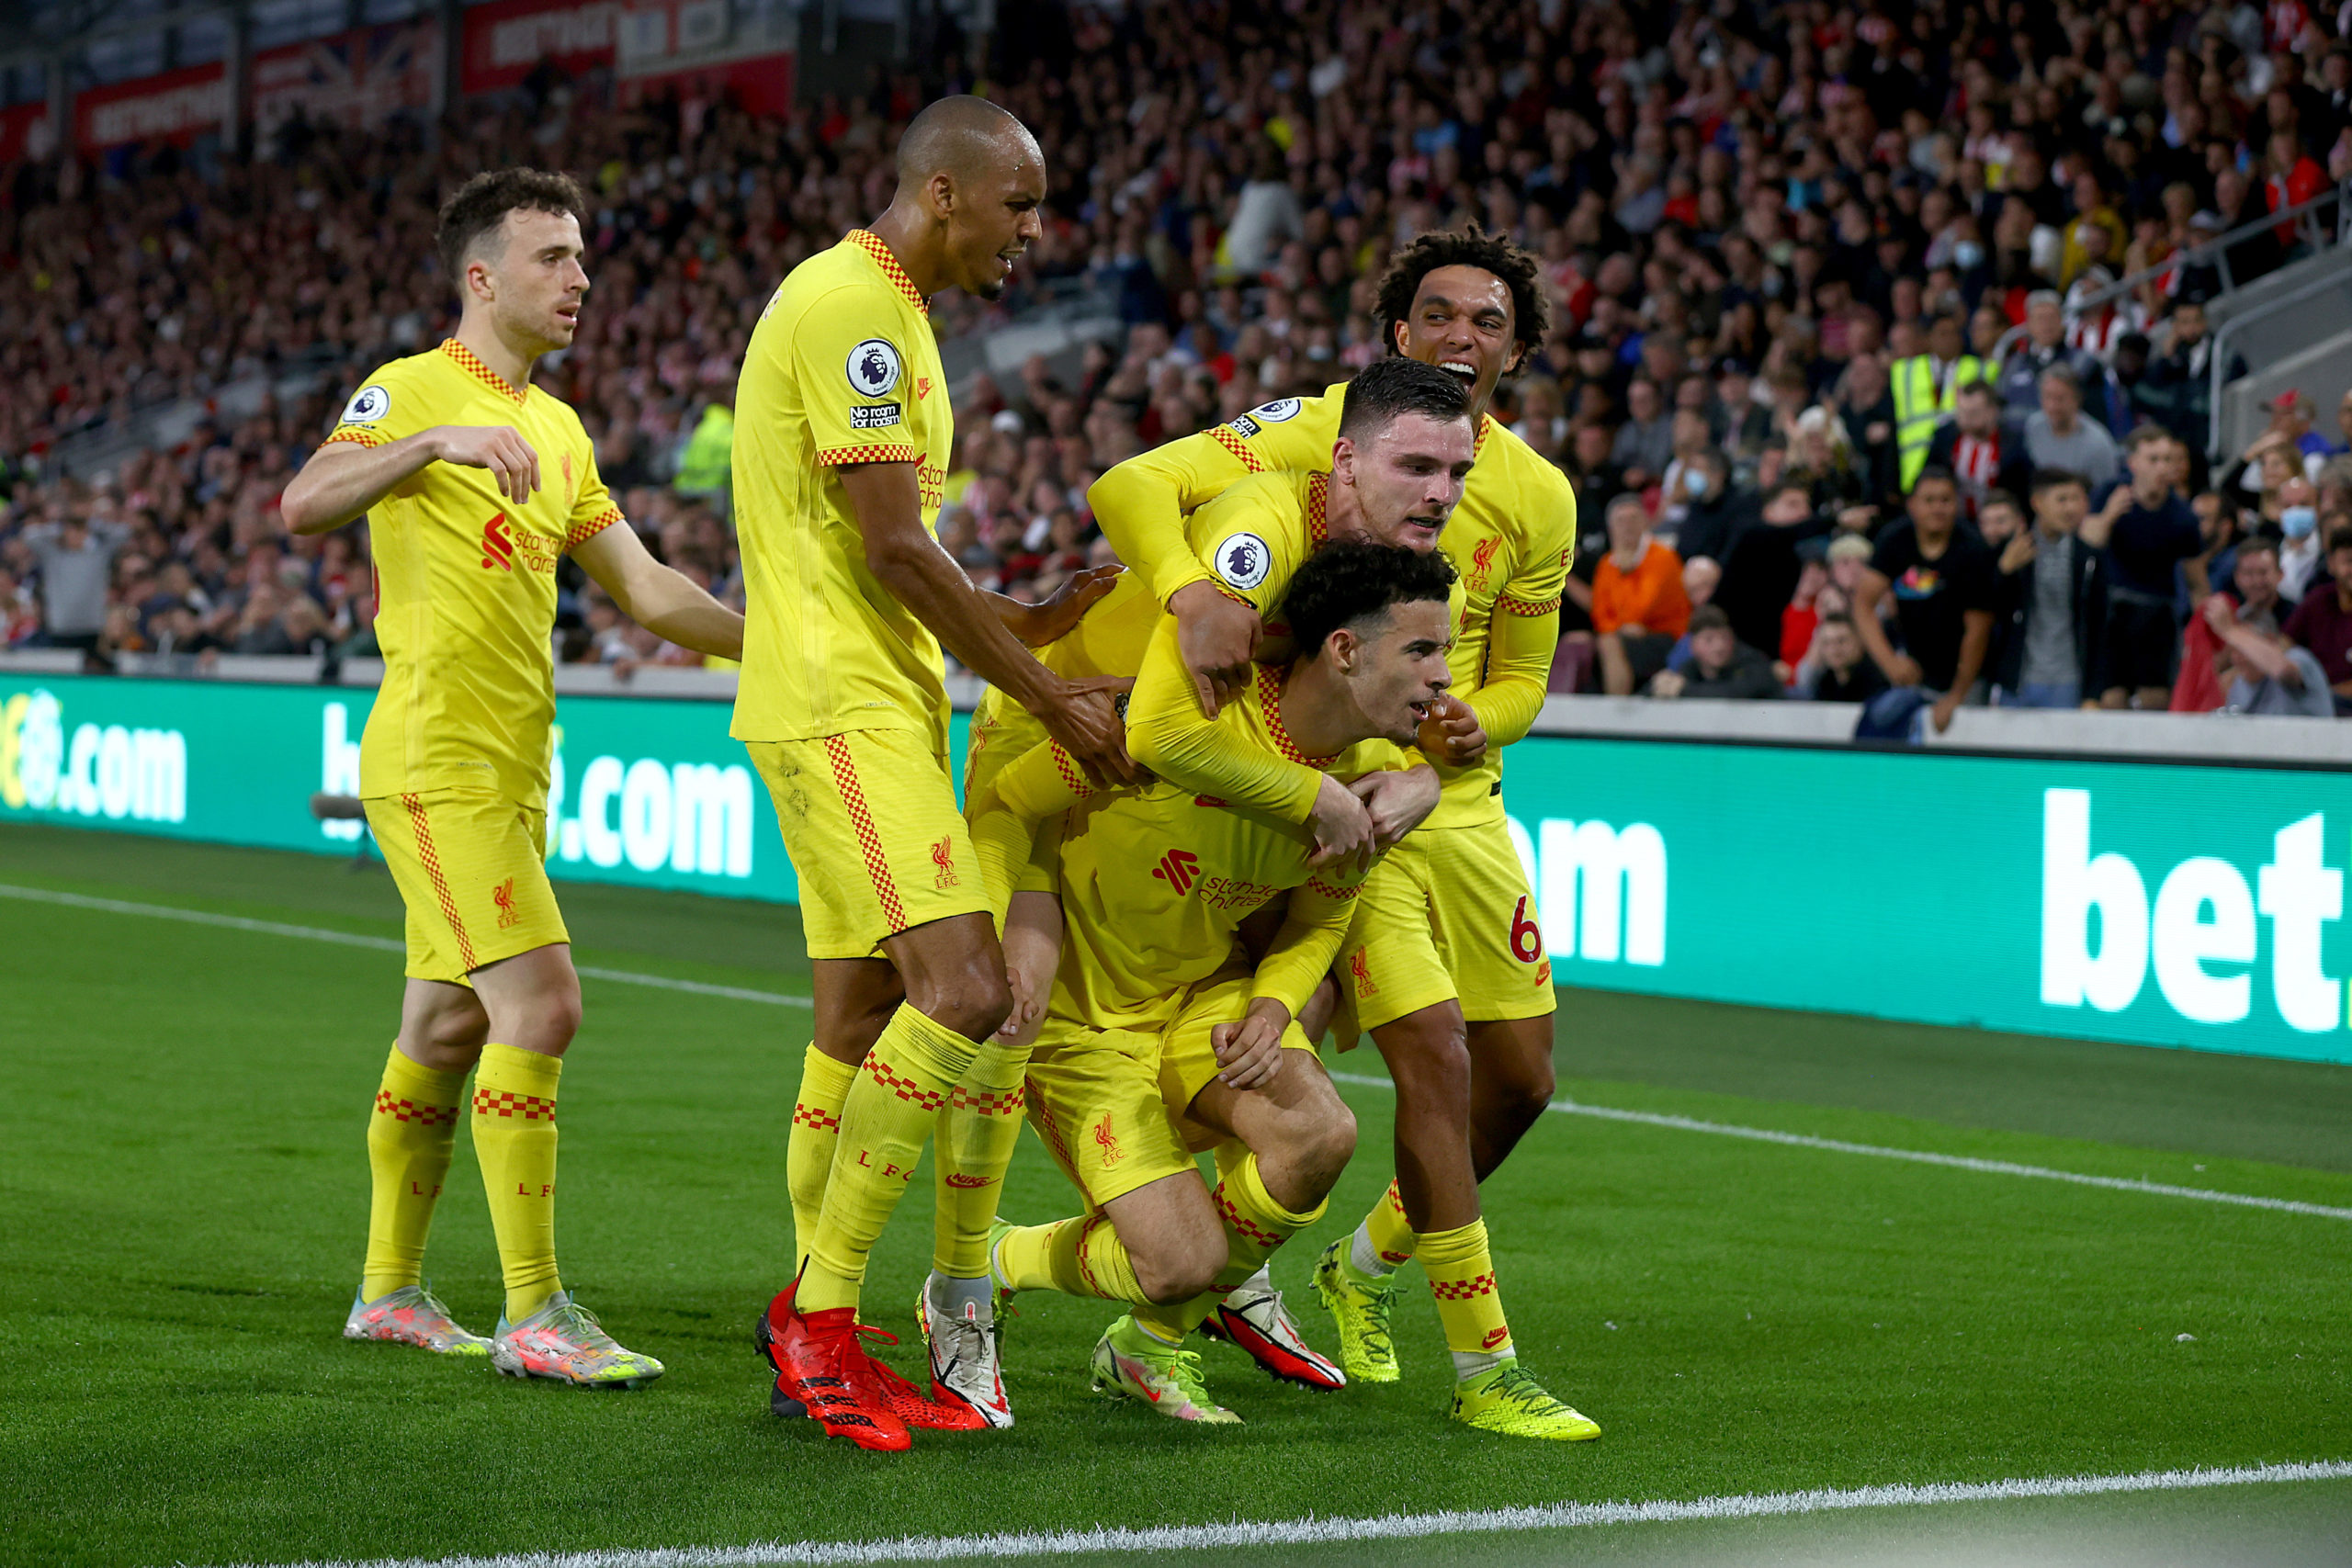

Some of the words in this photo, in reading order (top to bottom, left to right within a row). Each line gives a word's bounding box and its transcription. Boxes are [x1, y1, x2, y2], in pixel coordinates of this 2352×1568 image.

[850, 406, 869, 419] No
[870, 405, 896, 418] room
[851, 416, 869, 429] for
[870, 414, 900, 428] racism
[1509, 893, 1542, 964] 6
[2040, 787, 2352, 1034] bet
